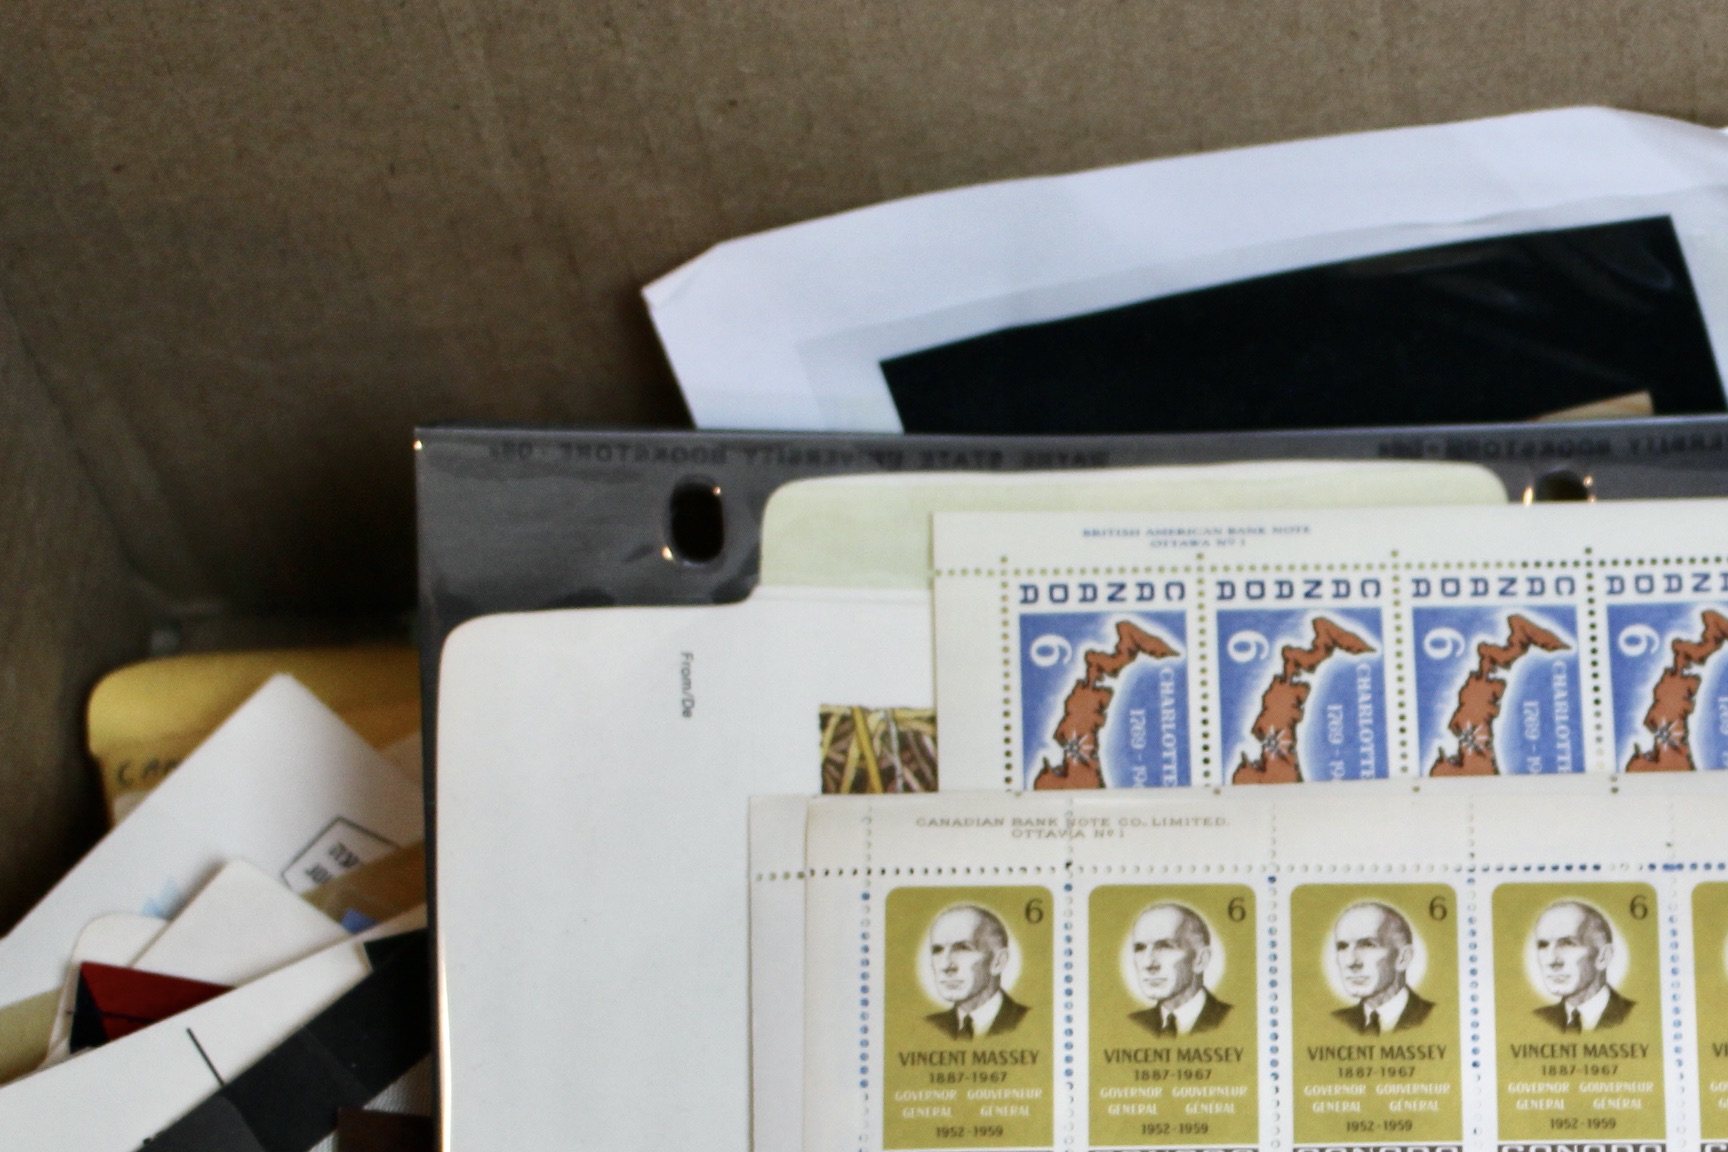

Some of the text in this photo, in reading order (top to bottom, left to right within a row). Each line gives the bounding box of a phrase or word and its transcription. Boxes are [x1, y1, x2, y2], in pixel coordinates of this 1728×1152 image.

[1019, 581, 1186, 604] CANADA
[1216, 578, 1382, 601] CANADA
[1411, 575, 1576, 599] CANADA
[1030, 634, 1072, 667] 6
[1227, 630, 1269, 663] 6
[1423, 627, 1465, 659] 6
[1617, 624, 1660, 656] 6
[681, 651, 695, 719] From/De
[915, 816, 1004, 827] CANADIAN
[1011, 816, 1059, 827] BANK
[1025, 898, 1044, 924] 6
[1227, 896, 1246, 922] 6
[1428, 895, 1448, 921] 6
[1628, 894, 1648, 920] 6
[899, 1049, 1039, 1067] VINCENT MASSEY
[1104, 1047, 1243, 1064] VINCENT MASSEY
[1307, 1044, 1446, 1062] VINCENT MASSEY
[1510, 1042, 1649, 1060] VINCENT MASSEY
[929, 1071, 1007, 1084] 1887-1967
[895, 1087, 1041, 1101] GOVERNOR GOUVERNEUR
[903, 1106, 951, 1118] GENERAL
